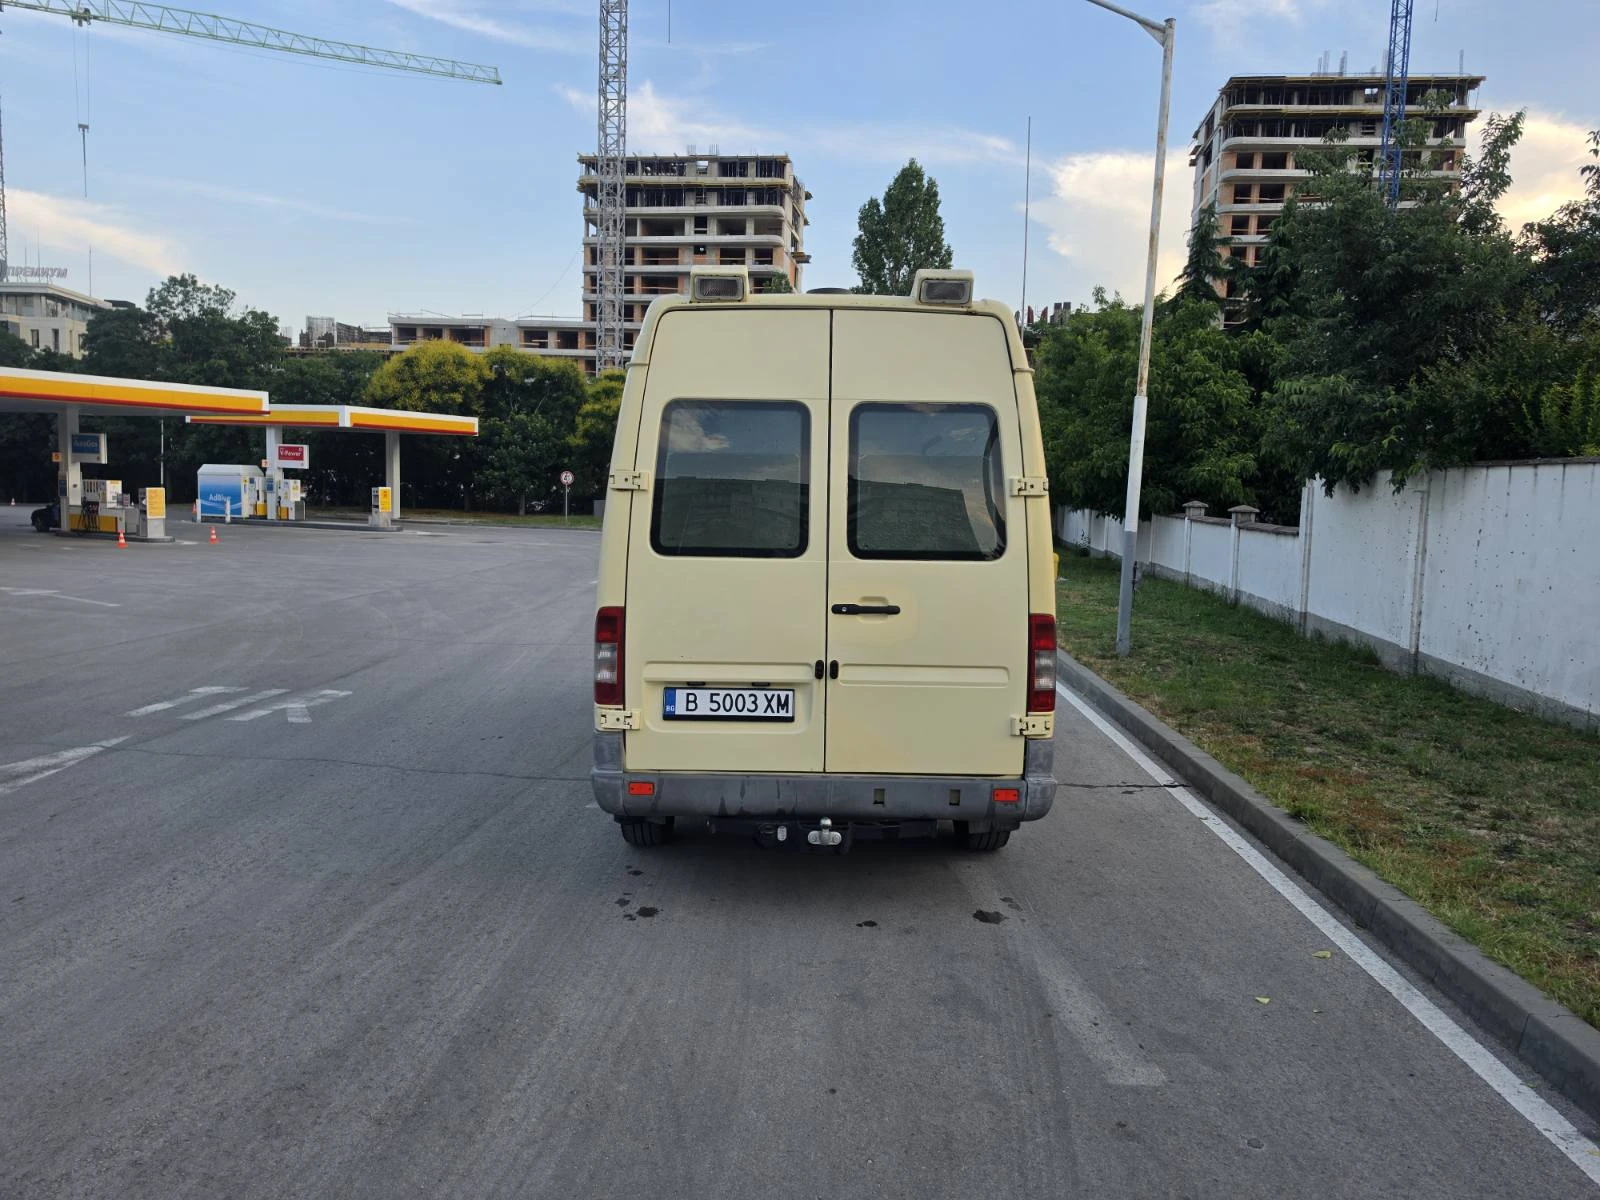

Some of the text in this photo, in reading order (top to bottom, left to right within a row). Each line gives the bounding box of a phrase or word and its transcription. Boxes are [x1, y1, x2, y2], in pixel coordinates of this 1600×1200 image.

[685, 692, 790, 714] B 5003 XM
